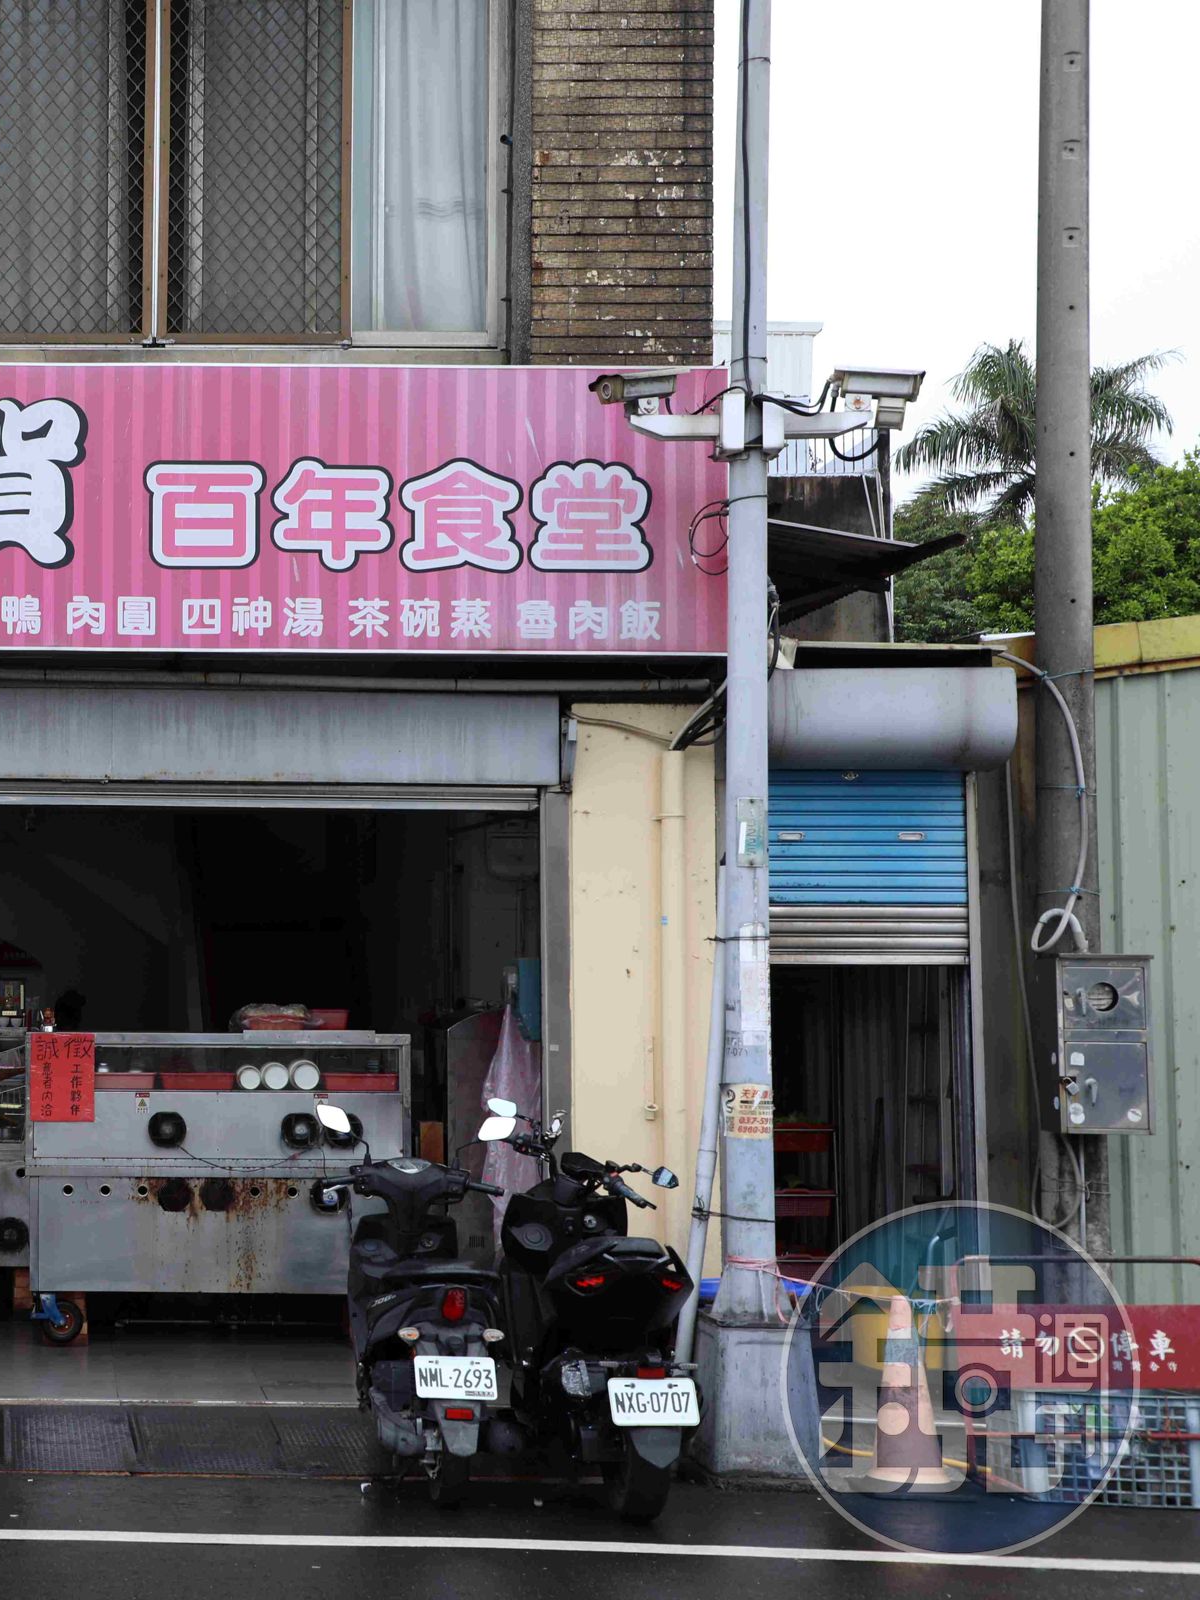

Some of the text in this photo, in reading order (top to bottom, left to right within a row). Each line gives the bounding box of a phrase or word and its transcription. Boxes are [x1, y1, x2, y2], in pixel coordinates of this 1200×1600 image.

[143, 456, 654, 574] 百年食堂
[66, 595, 156, 637] 肉圓
[181, 596, 325, 637] 四神湯
[348, 597, 493, 639] 茶碗蒸
[516, 599, 662, 641] 魯肉飯
[999, 1328, 1176, 1360] 請勿 停車
